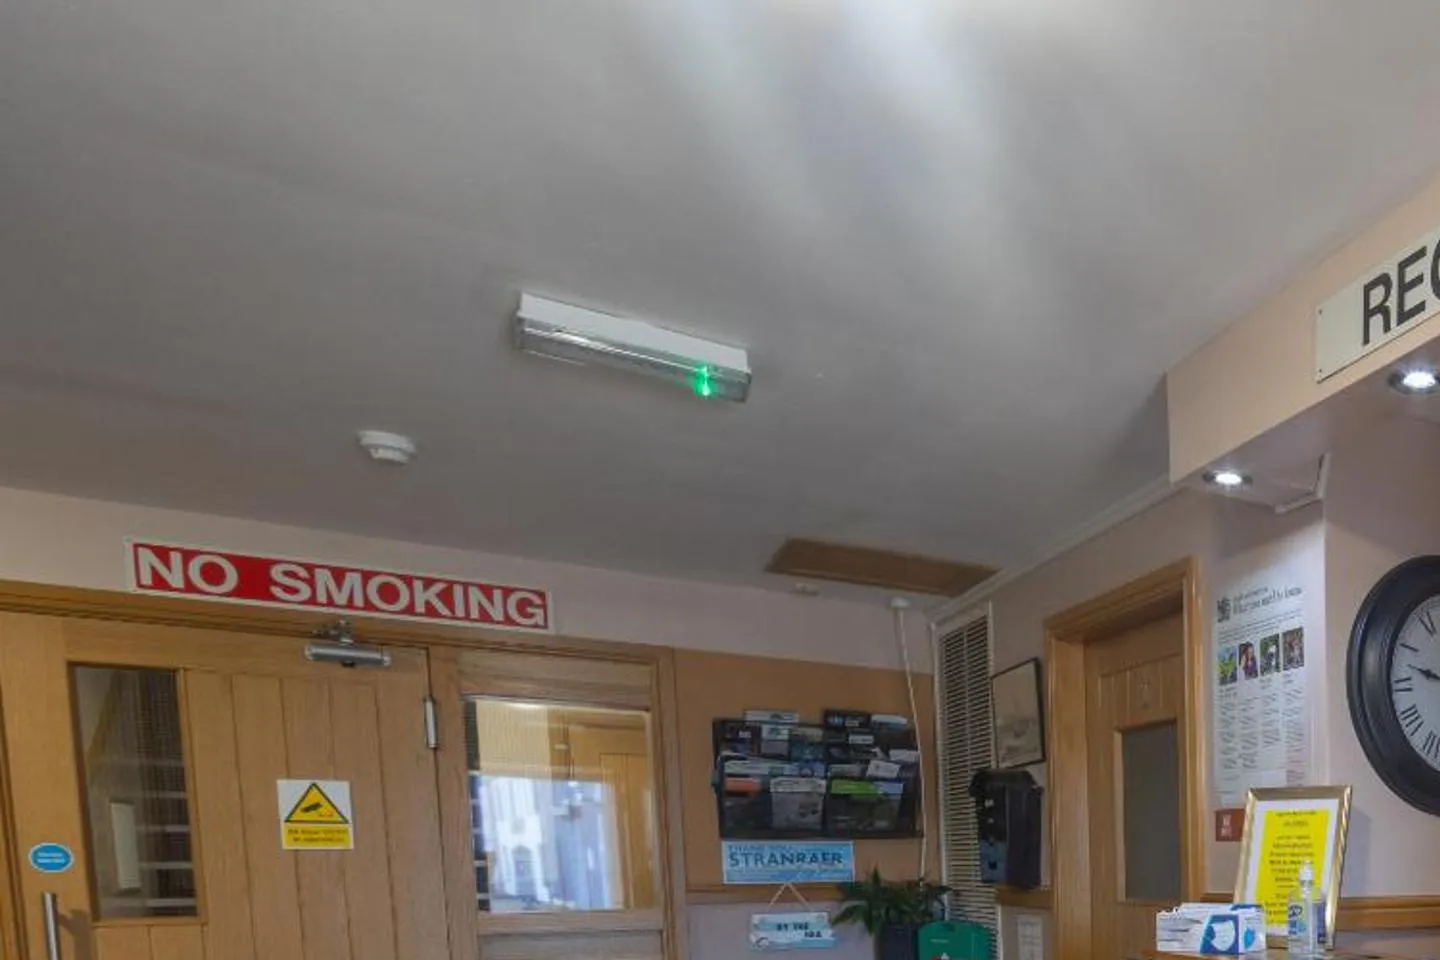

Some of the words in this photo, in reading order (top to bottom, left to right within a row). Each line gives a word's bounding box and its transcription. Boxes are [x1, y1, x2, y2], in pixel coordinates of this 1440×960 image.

[138, 547, 239, 595] NO
[269, 562, 546, 627] SMOKING
[729, 852, 843, 867] STRANRAER
